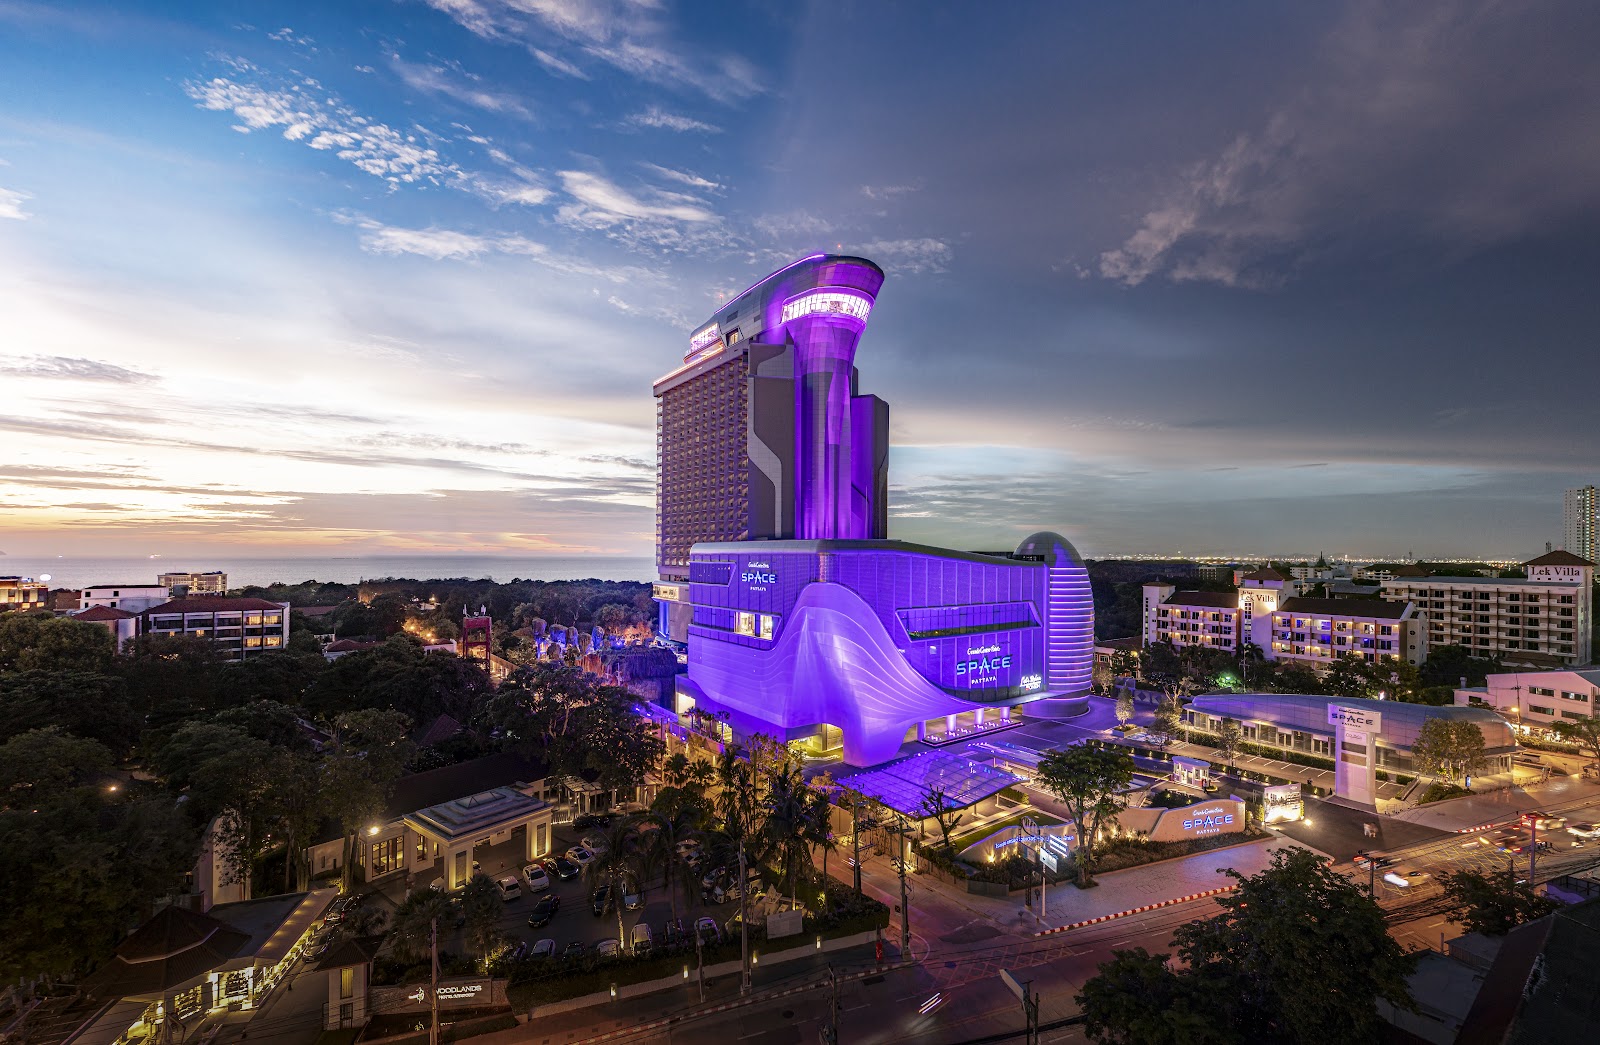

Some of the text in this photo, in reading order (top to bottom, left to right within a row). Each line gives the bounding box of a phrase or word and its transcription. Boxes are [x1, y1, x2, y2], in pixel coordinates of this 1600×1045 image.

[741, 570, 776, 585] SPACE
[1531, 566, 1580, 576] Lek Villa
[1256, 594, 1275, 603] Villa
[956, 656, 1011, 676] SPACE
[971, 675, 997, 685] PATTAYA
[1331, 713, 1374, 726] SPACE
[1183, 814, 1234, 830] SPACE
